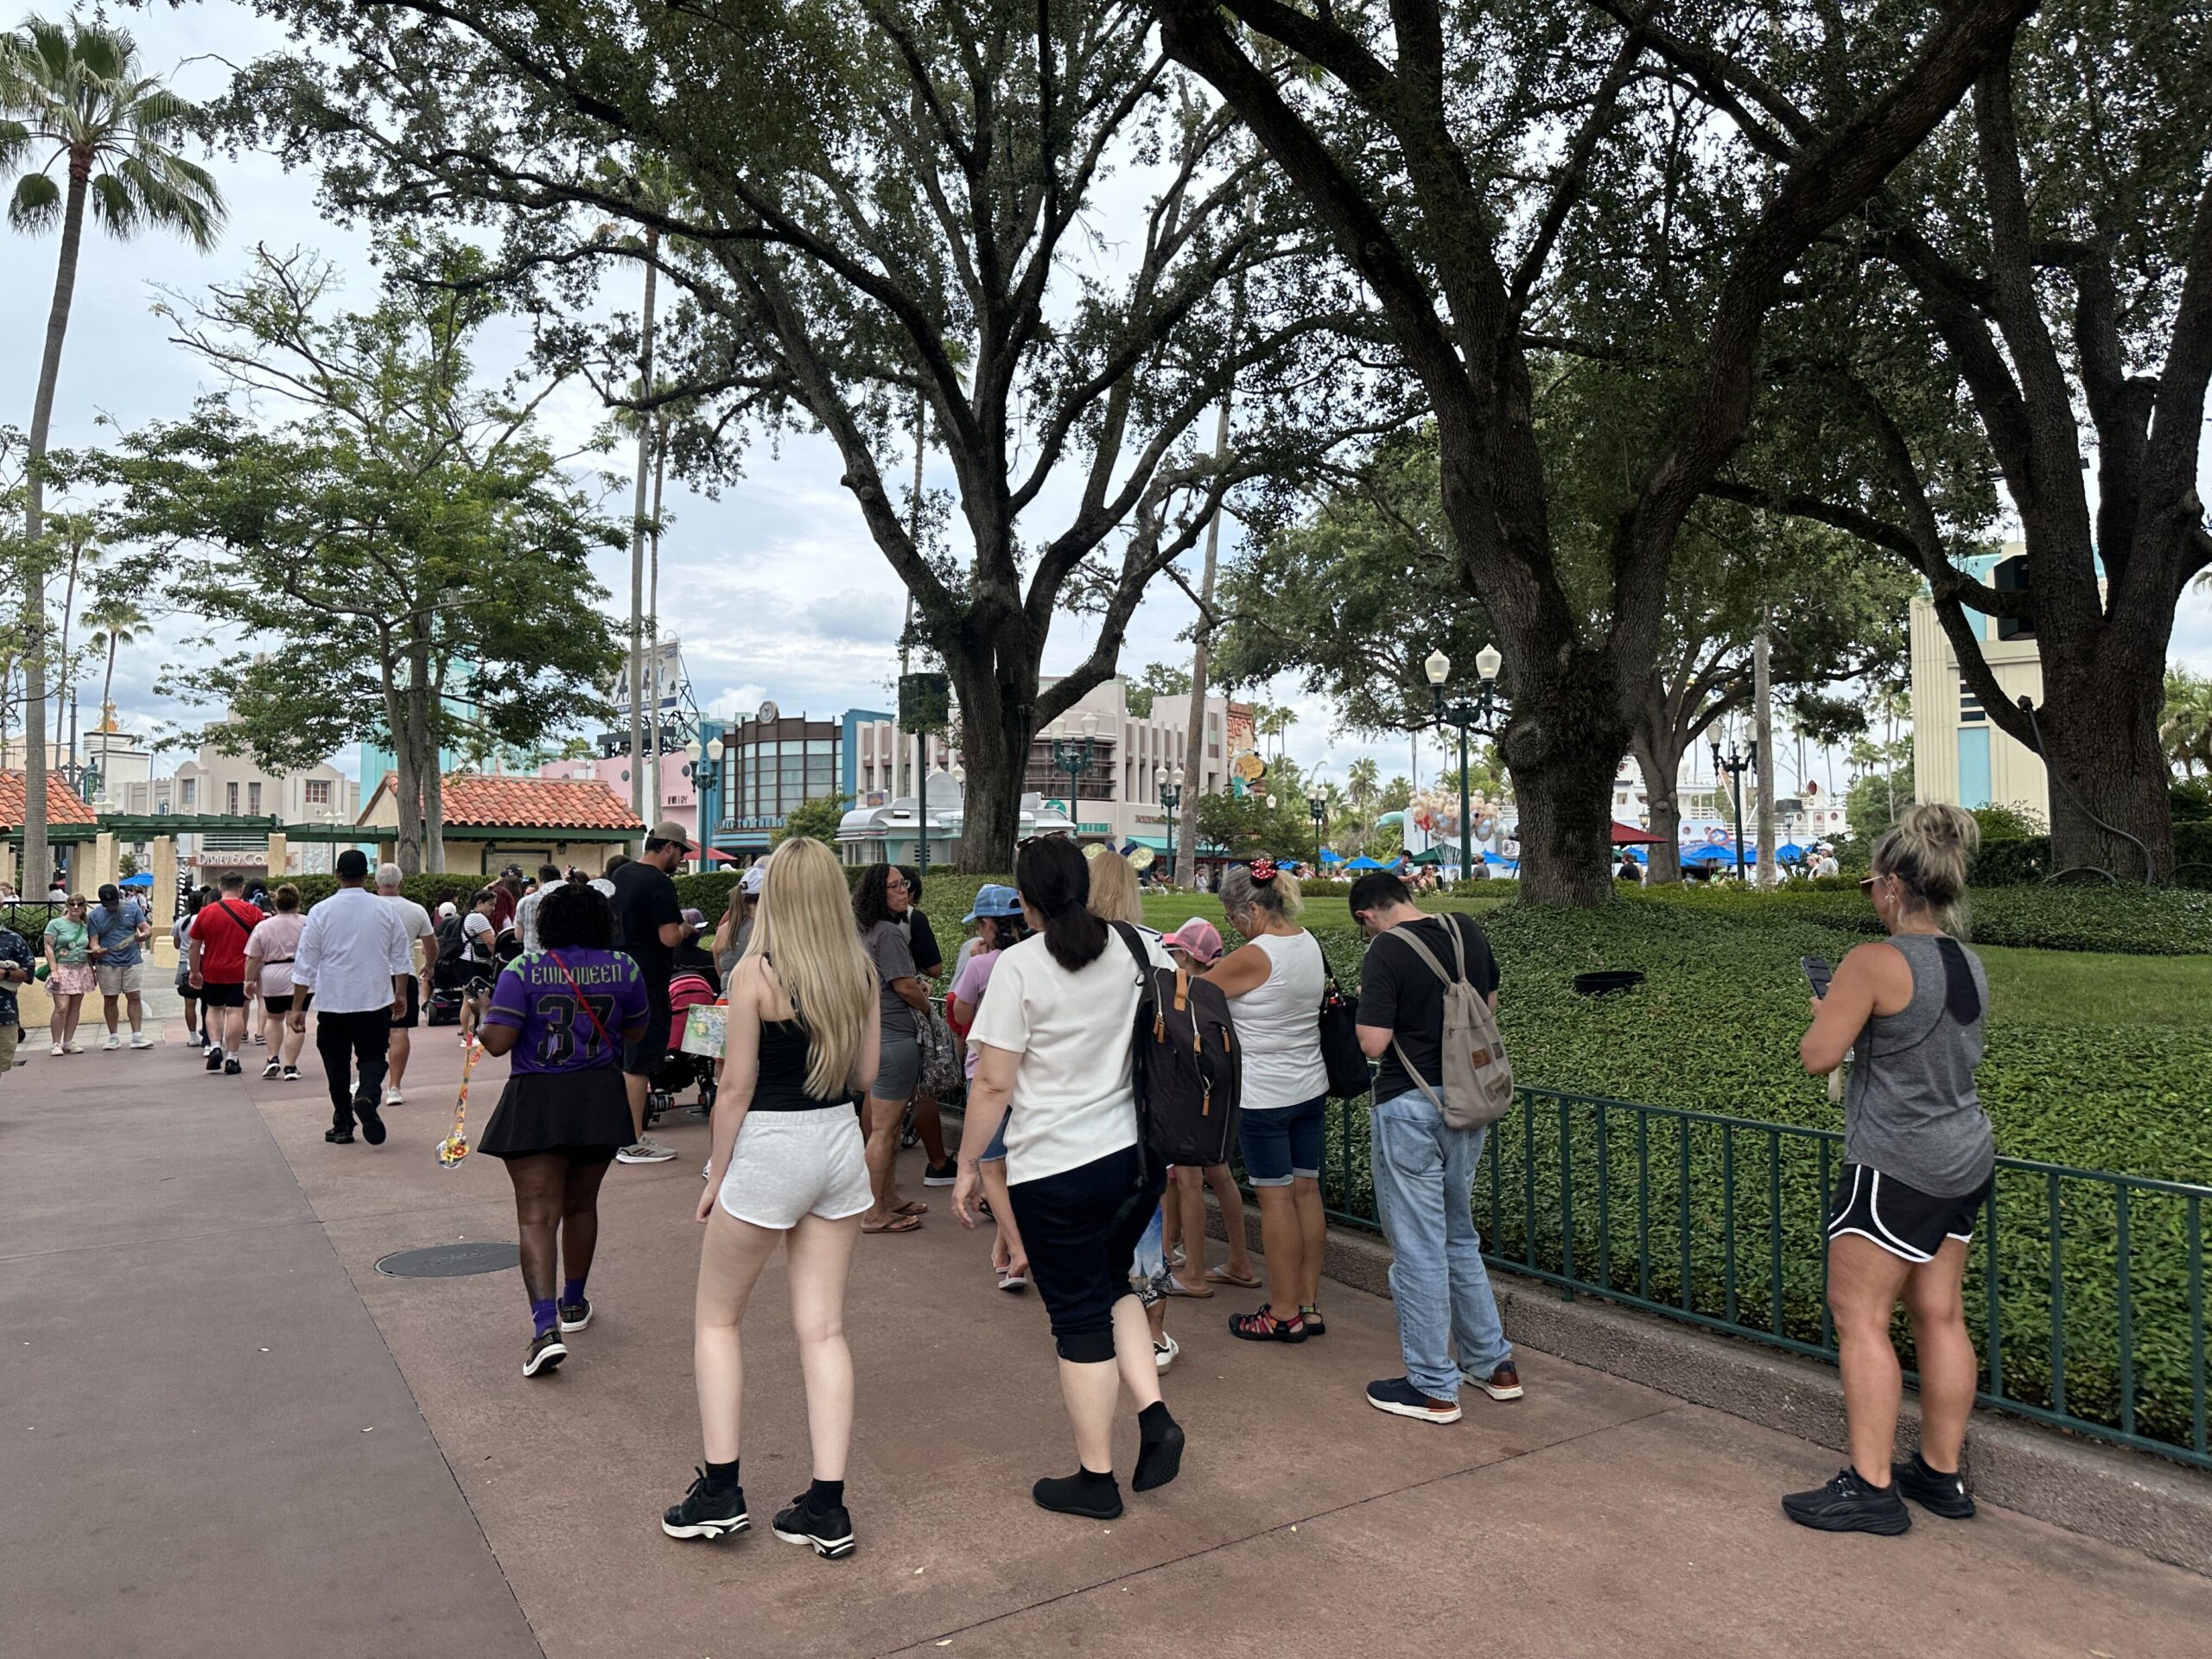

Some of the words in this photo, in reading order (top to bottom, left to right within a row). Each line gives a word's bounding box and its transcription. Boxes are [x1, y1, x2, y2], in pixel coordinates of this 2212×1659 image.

[232, 855, 241, 865] &
[571, 963, 622, 985] QUEEN
[537, 995, 615, 1066] 37
